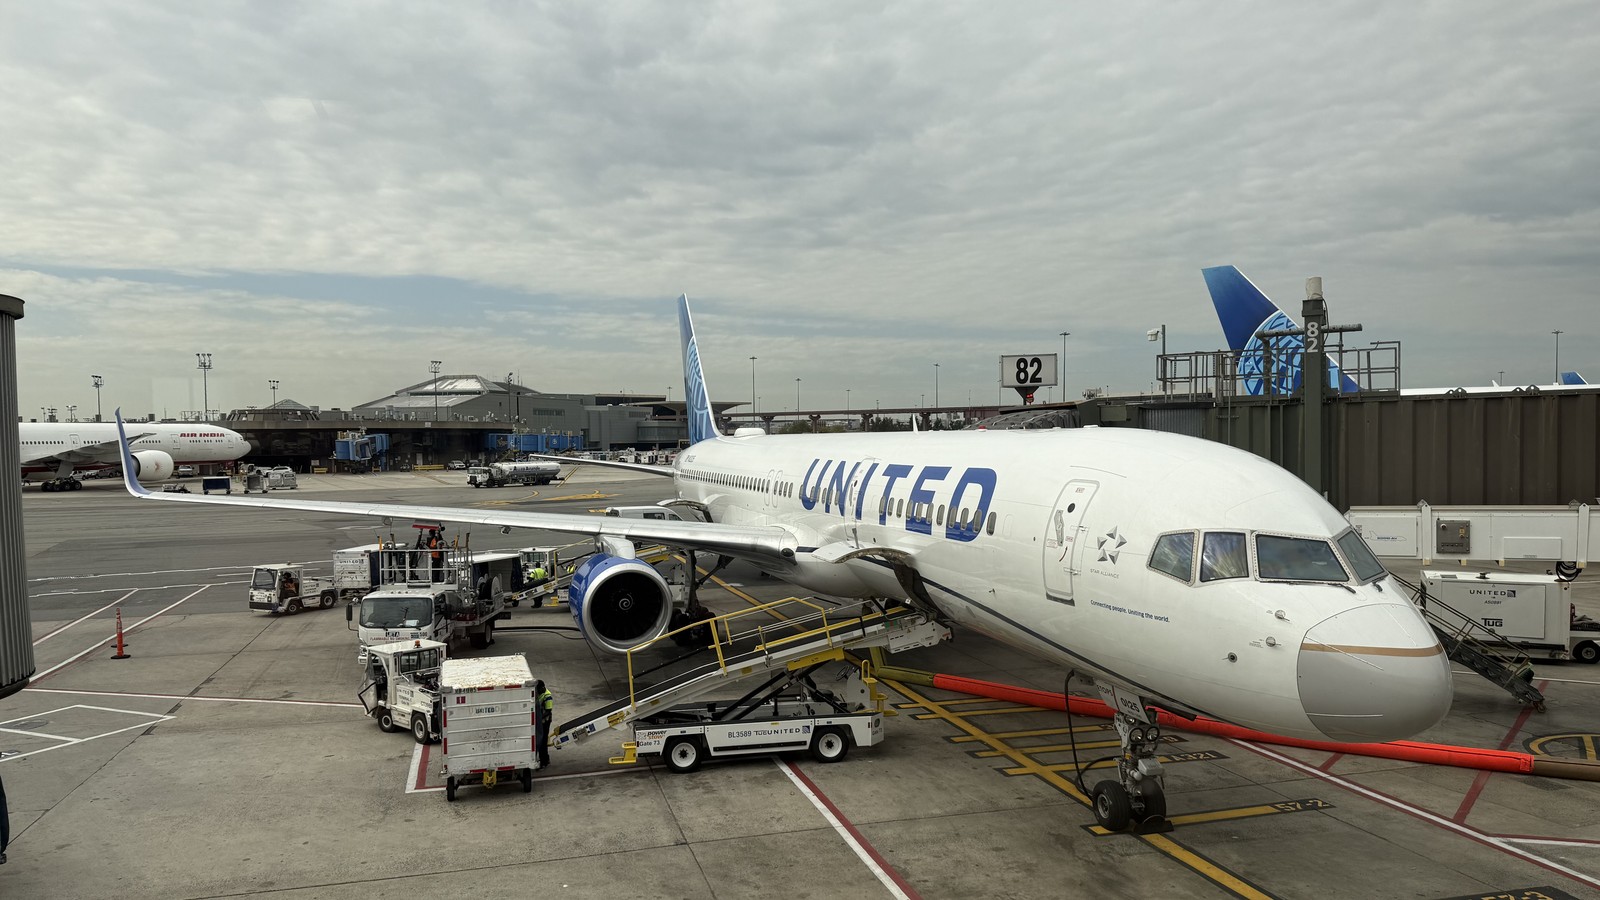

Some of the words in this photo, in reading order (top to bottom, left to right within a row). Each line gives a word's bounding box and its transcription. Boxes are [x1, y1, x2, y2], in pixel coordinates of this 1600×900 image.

[1015, 357, 1042, 384] 82
[802, 458, 998, 542] UNITED
[1090, 599, 1112, 611] Connecting
[1112, 605, 1127, 614] people.
[1127, 608, 1144, 618] Uniting
[1154, 614, 1170, 623] world.
[1481, 618, 1503, 627] TUG
[727, 730, 752, 738] BL3589
[767, 727, 800, 735] UNITED
[1171, 751, 1217, 762] A321
